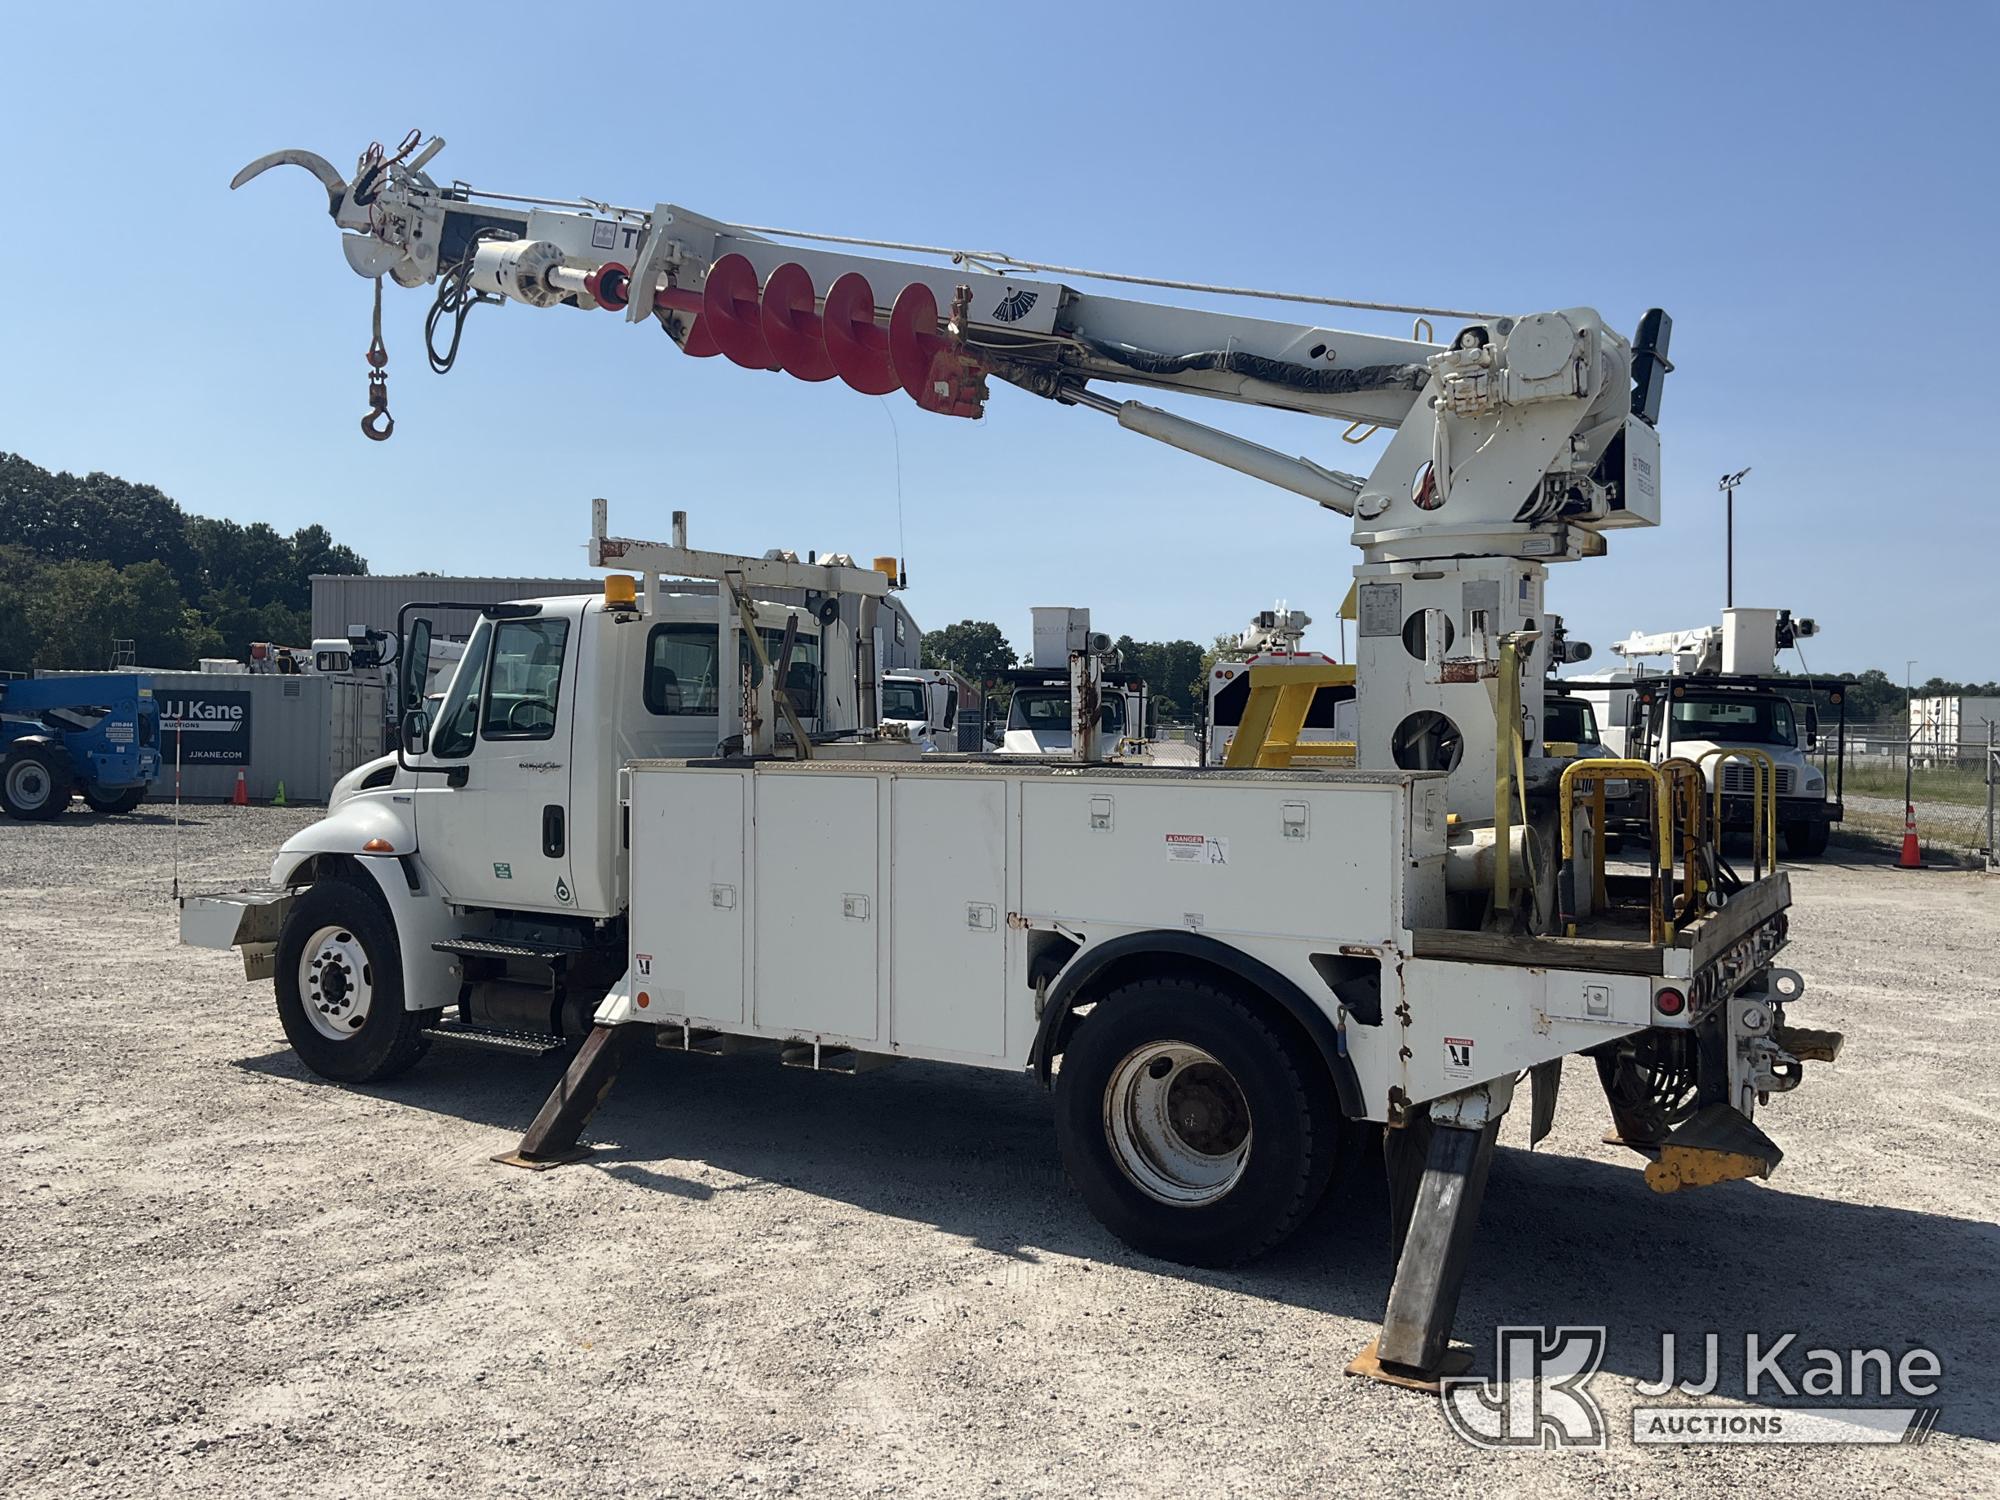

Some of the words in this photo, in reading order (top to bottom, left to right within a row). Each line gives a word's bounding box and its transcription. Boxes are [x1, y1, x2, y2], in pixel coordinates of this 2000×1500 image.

[160, 701, 184, 718] JJ
[189, 701, 243, 719] Kane
[189, 751, 242, 759] JJKANE.COM
